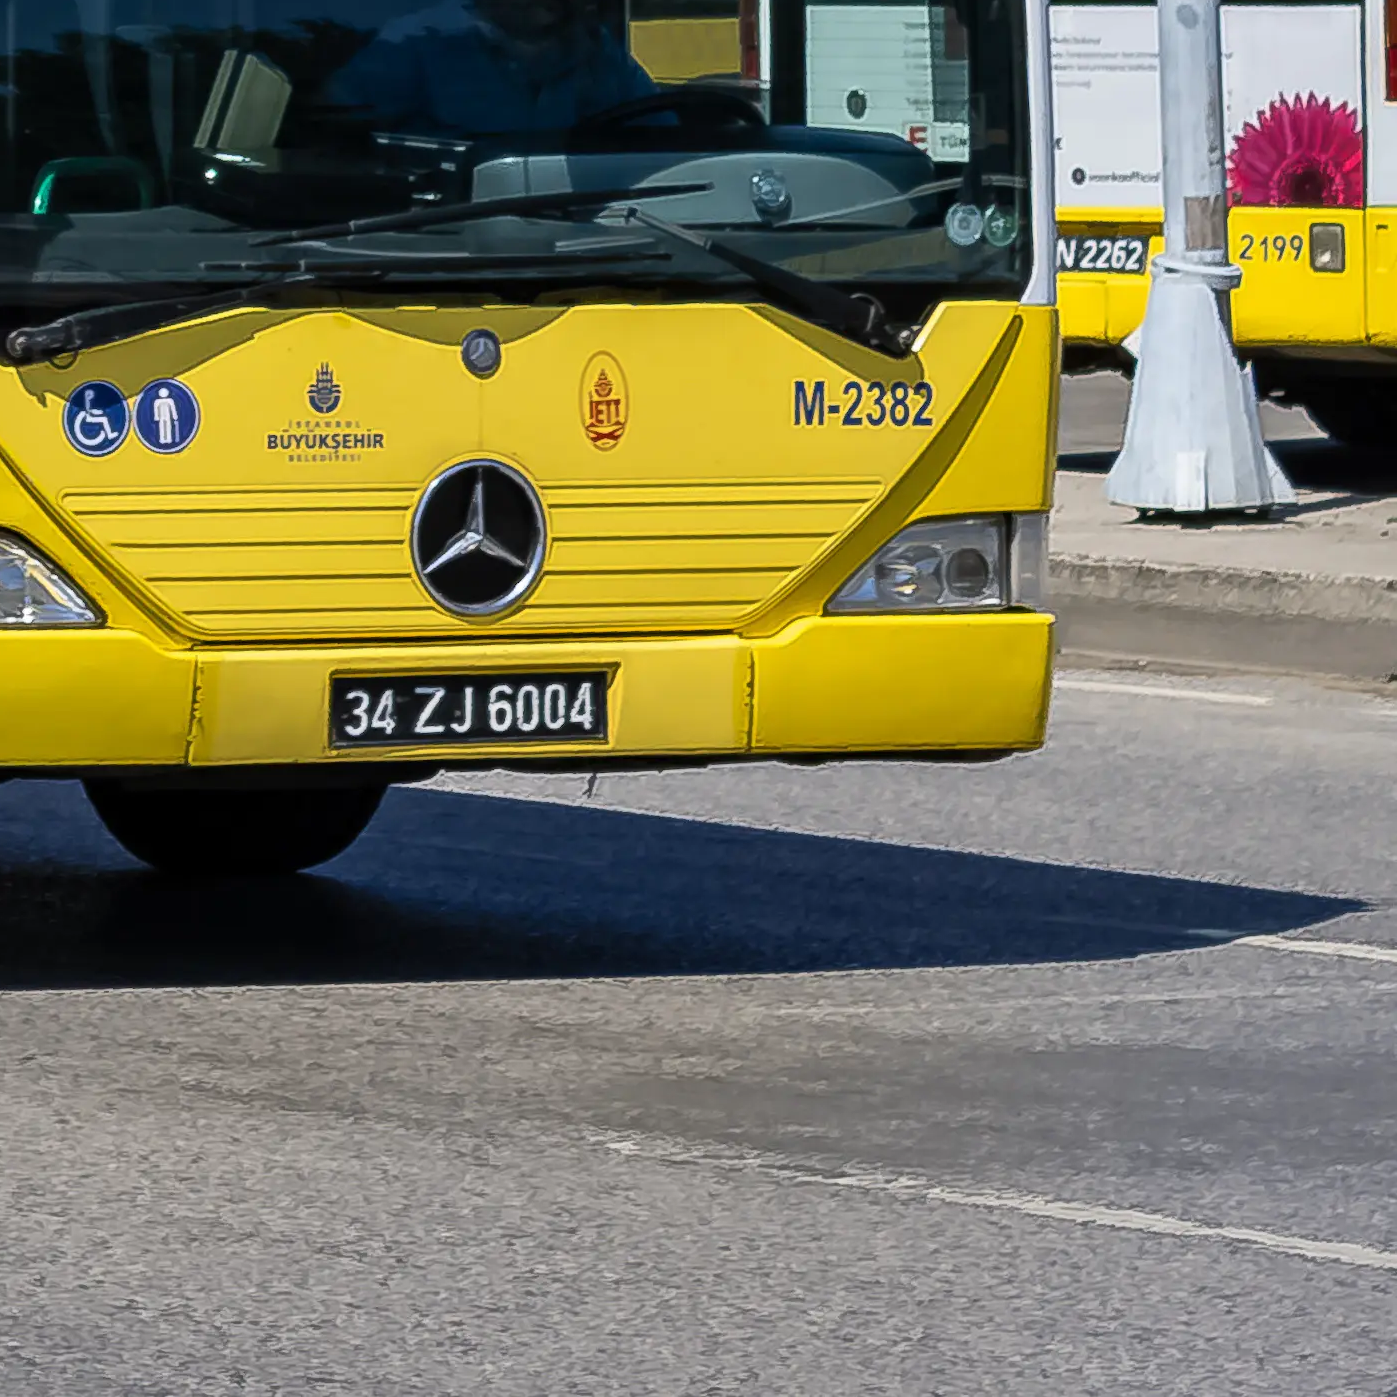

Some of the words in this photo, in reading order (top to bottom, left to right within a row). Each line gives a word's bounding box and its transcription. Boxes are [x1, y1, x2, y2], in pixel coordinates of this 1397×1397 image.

[1079, 238, 1144, 271] 2262
[1238, 233, 1305, 262] 2199
[793, 379, 934, 427] M-2382
[267, 428, 385, 454] BÜYÜKŞEHİR
[343, 688, 397, 737] 34
[414, 686, 474, 734] ZJ
[488, 681, 594, 732] 6004
